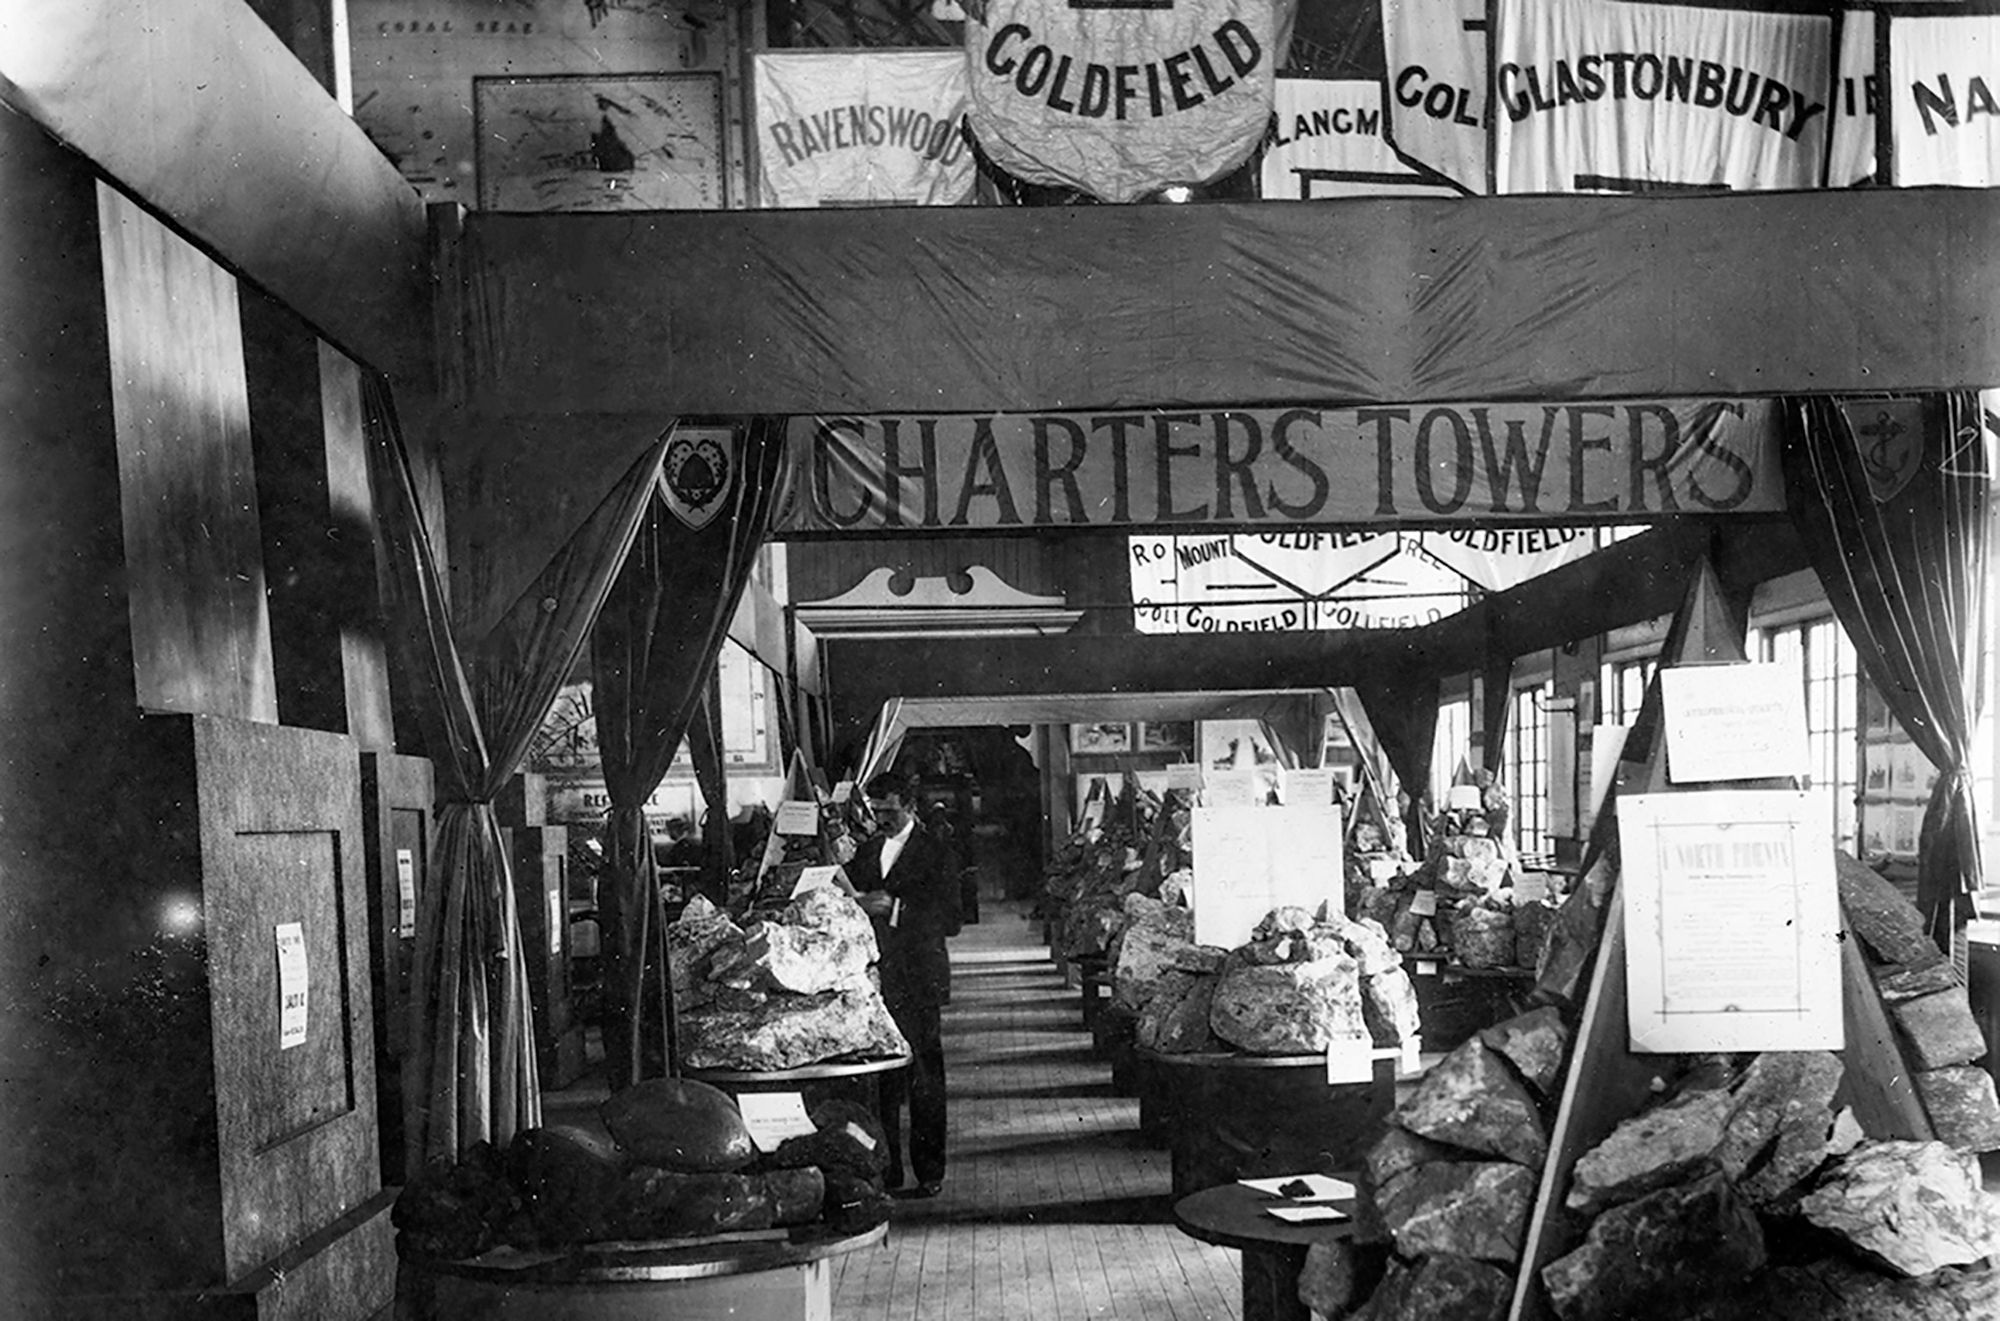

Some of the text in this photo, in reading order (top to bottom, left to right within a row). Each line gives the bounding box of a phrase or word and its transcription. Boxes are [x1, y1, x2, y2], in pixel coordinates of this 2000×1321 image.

[1396, 65, 1488, 130] GOL
[1499, 52, 1826, 142] GLASTONBURY
[770, 104, 966, 169] RAVENSWOOD
[813, 402, 1752, 528] CHARTERS TOWERS
[1178, 539, 1229, 571] MOUNT
[1247, 530, 1386, 551] OLDFIEL
[1436, 528, 1586, 554] OLDFIELD.
